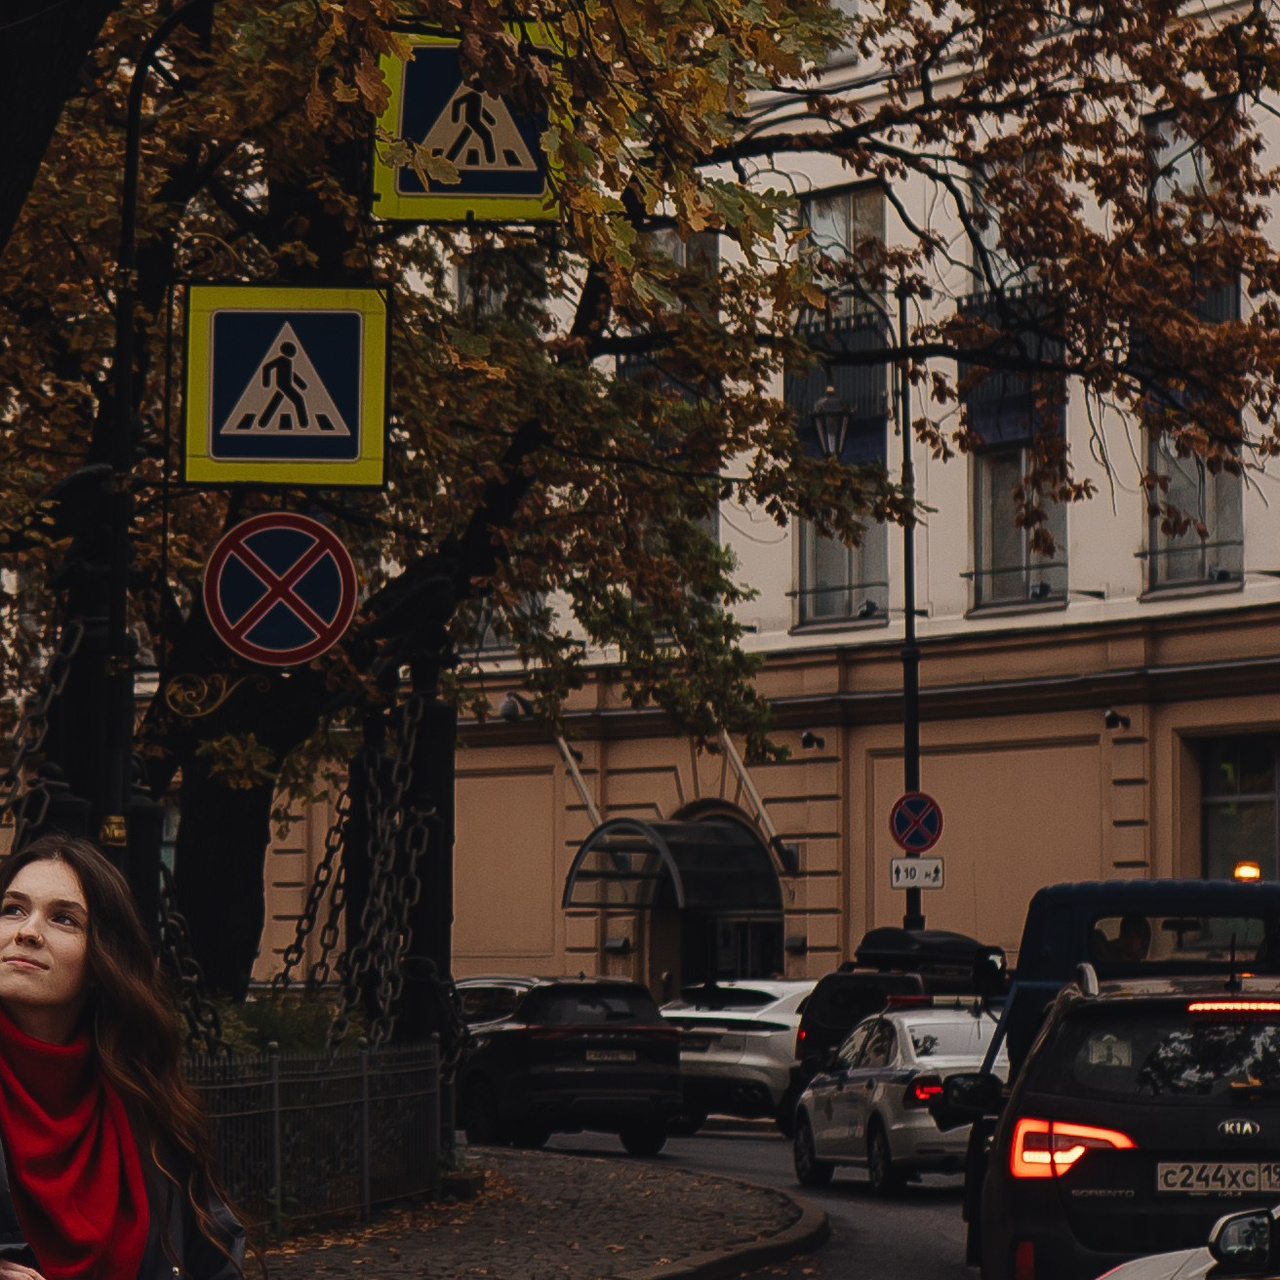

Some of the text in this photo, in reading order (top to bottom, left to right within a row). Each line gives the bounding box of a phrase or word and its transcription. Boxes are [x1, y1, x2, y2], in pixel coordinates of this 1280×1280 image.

[904, 866, 917, 880] 10
[1224, 1122, 1253, 1135] KIA
[1071, 1188, 1135, 1198] SORENTO
